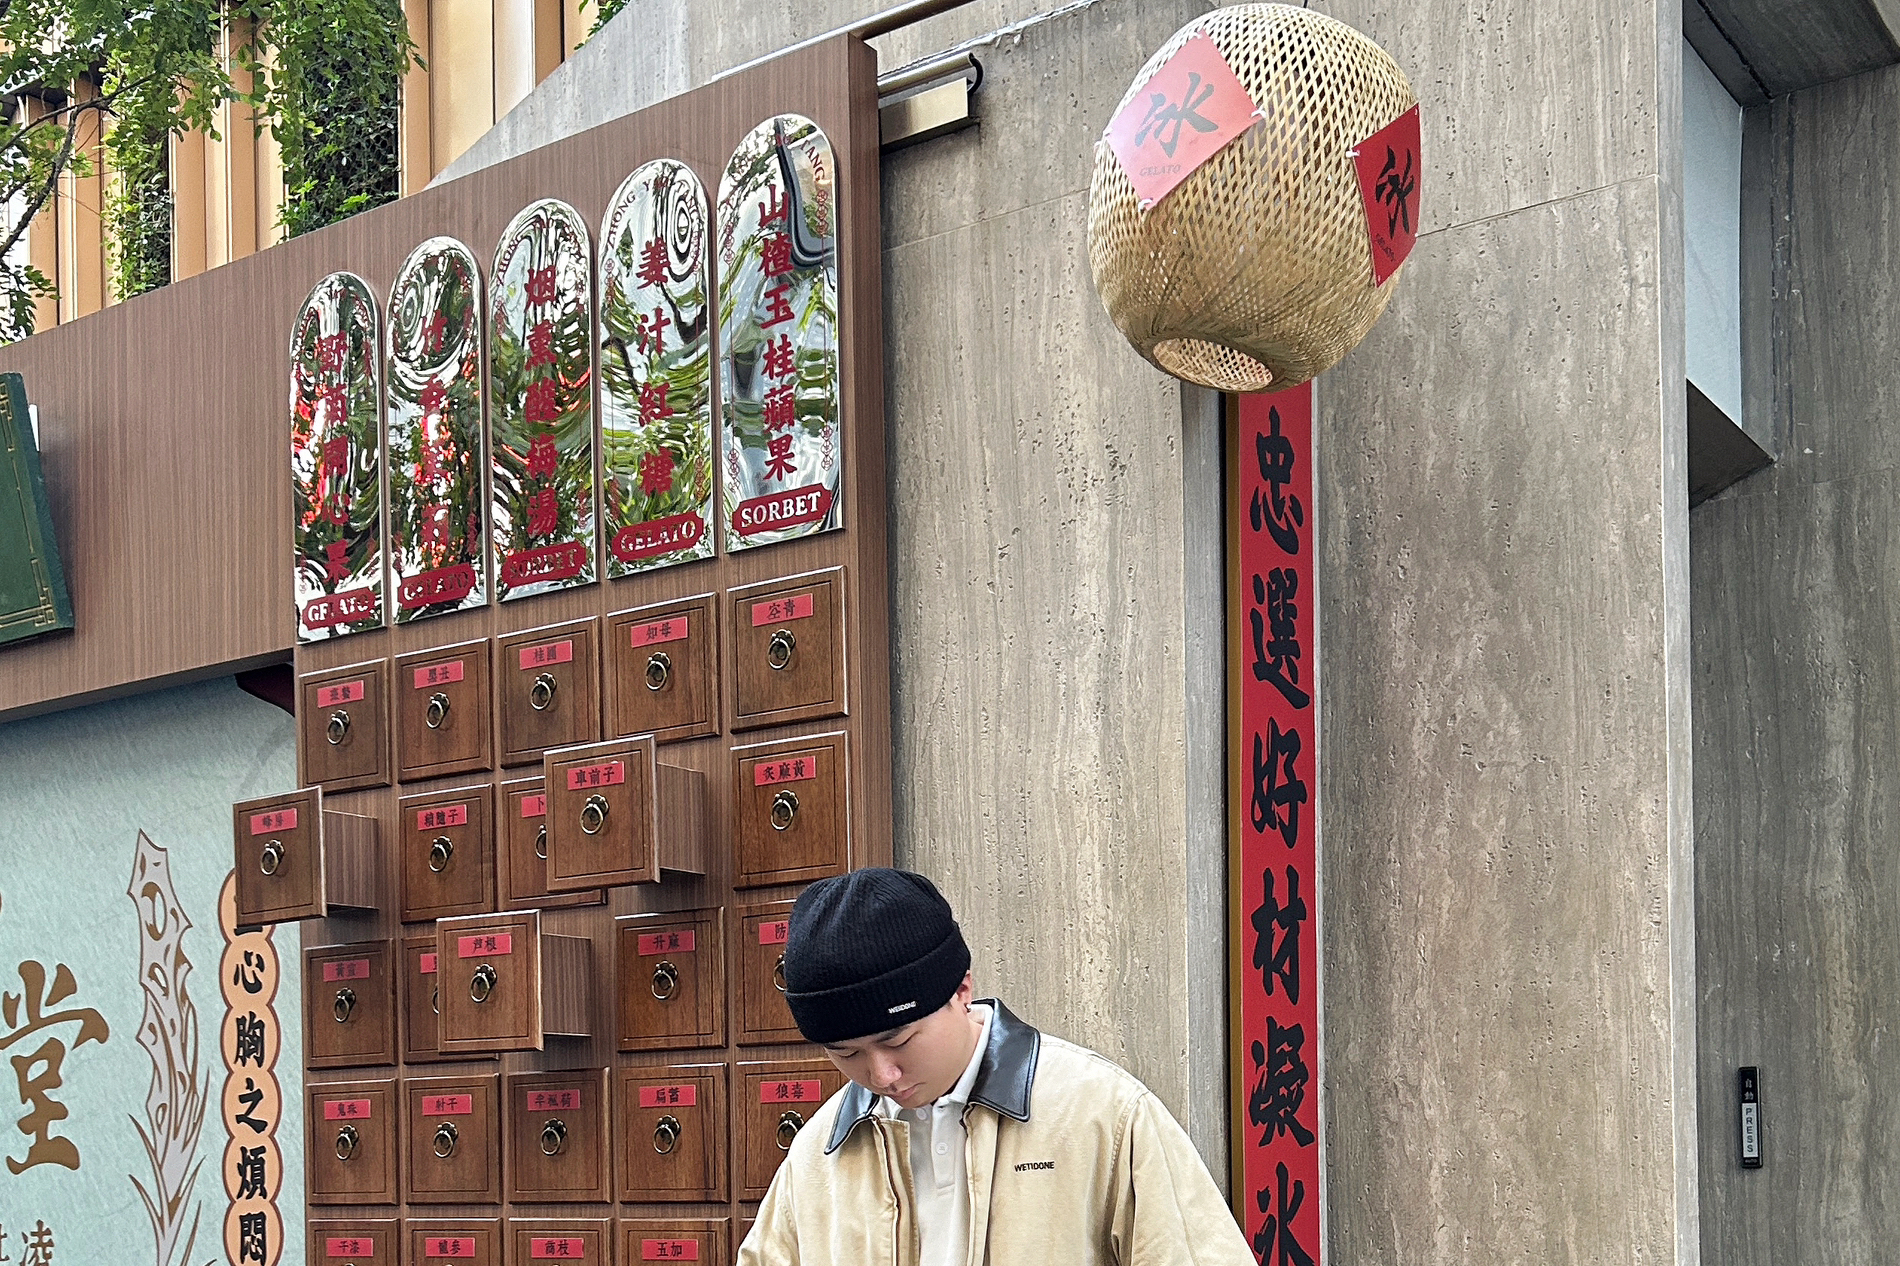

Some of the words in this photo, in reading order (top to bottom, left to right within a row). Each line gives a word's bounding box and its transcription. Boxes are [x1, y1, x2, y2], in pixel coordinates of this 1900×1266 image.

[1134, 72, 1219, 158] 冰
[758, 184, 798, 482] 山楂玉桂蘋果
[740, 489, 822, 528] SORBET
[620, 519, 696, 553] GELATO
[645, 621, 672, 642] 知母
[574, 765, 615, 787] 車前子
[0, 960, 109, 1175] 堂
[233, 896, 267, 1266] 心胸之煩悶
[1745, 1108, 1754, 1152] PRESS
